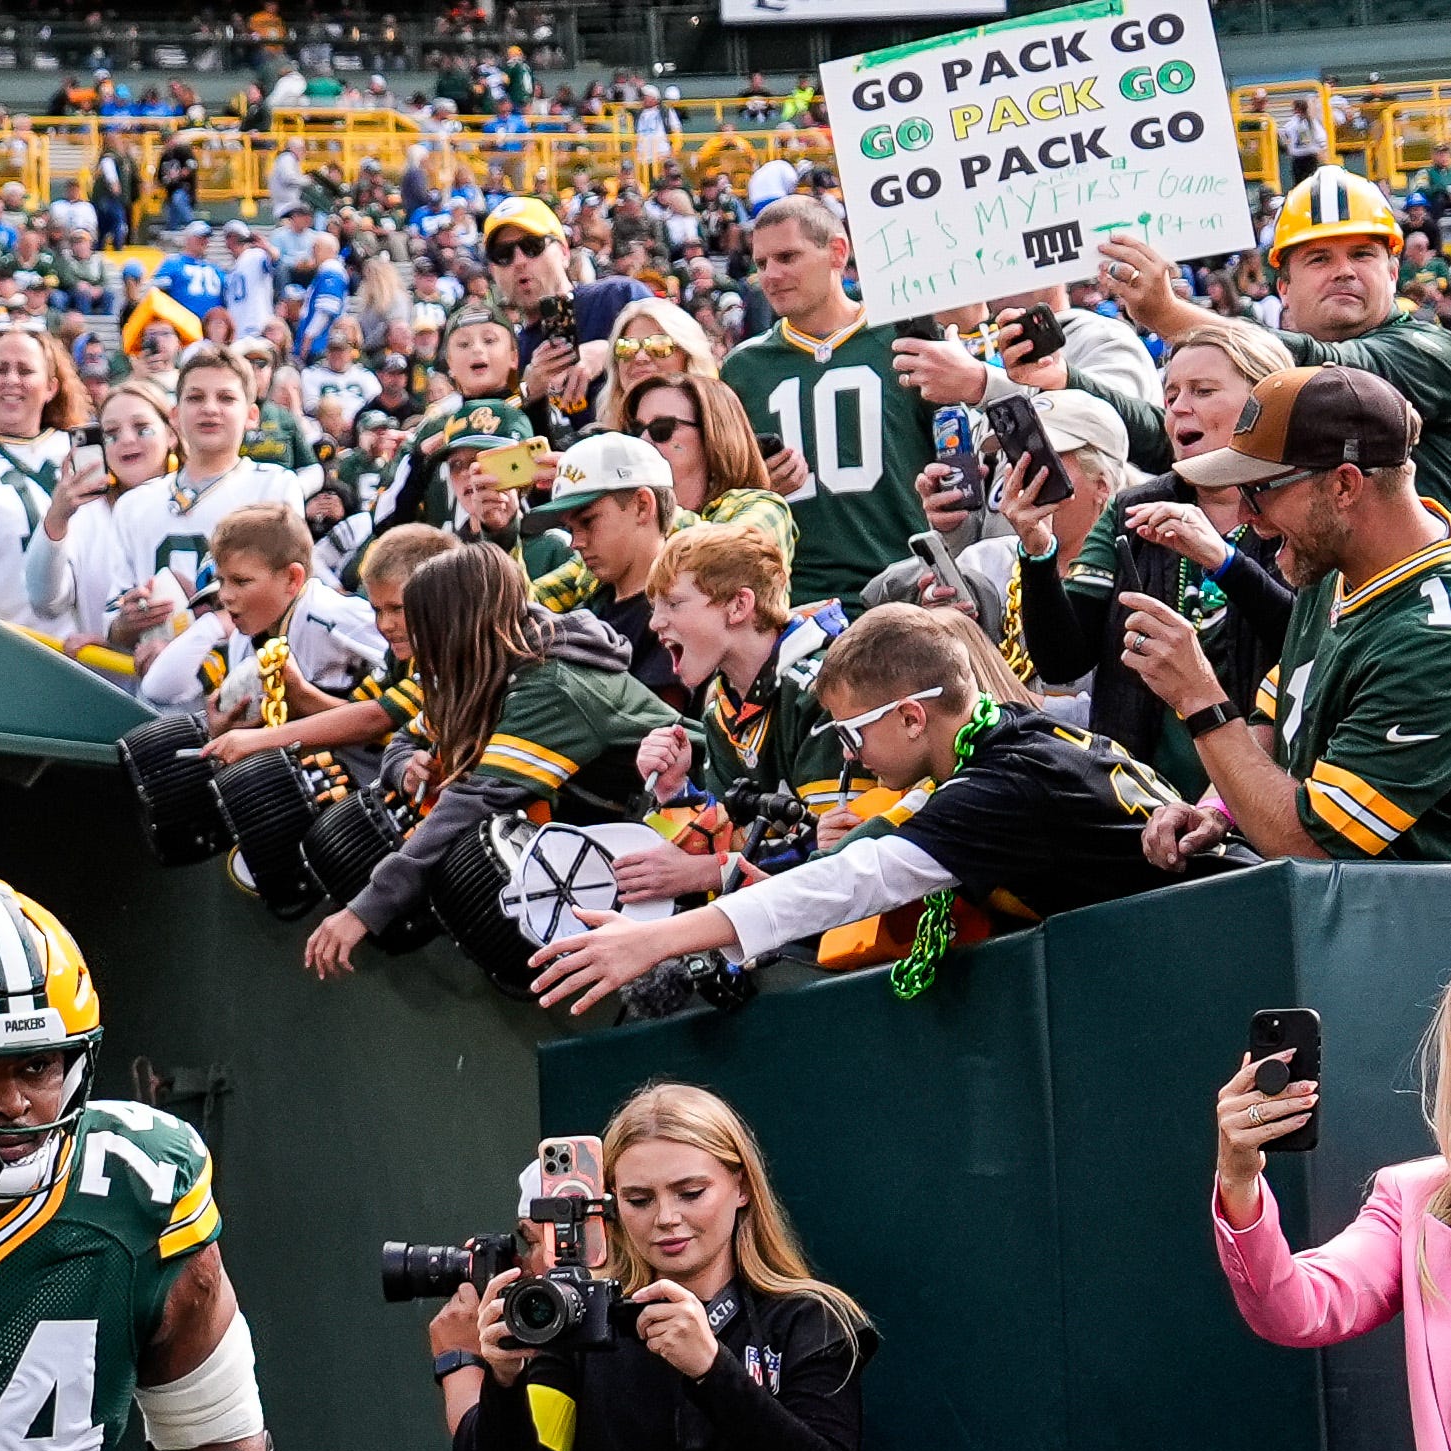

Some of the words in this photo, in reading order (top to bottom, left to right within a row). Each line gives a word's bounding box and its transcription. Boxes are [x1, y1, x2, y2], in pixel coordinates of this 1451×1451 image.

[852, 71, 924, 112] GO
[941, 30, 1094, 94] PACK
[1110, 13, 1186, 53] GO
[859, 116, 934, 160] GO
[949, 76, 1105, 141] PACK
[1118, 59, 1196, 102] GO
[870, 167, 942, 208] GO
[959, 126, 1113, 190] PACK
[1130, 111, 1205, 151] GO
[768, 365, 883, 502] 10
[5, 1016, 46, 1033] PACKERS
